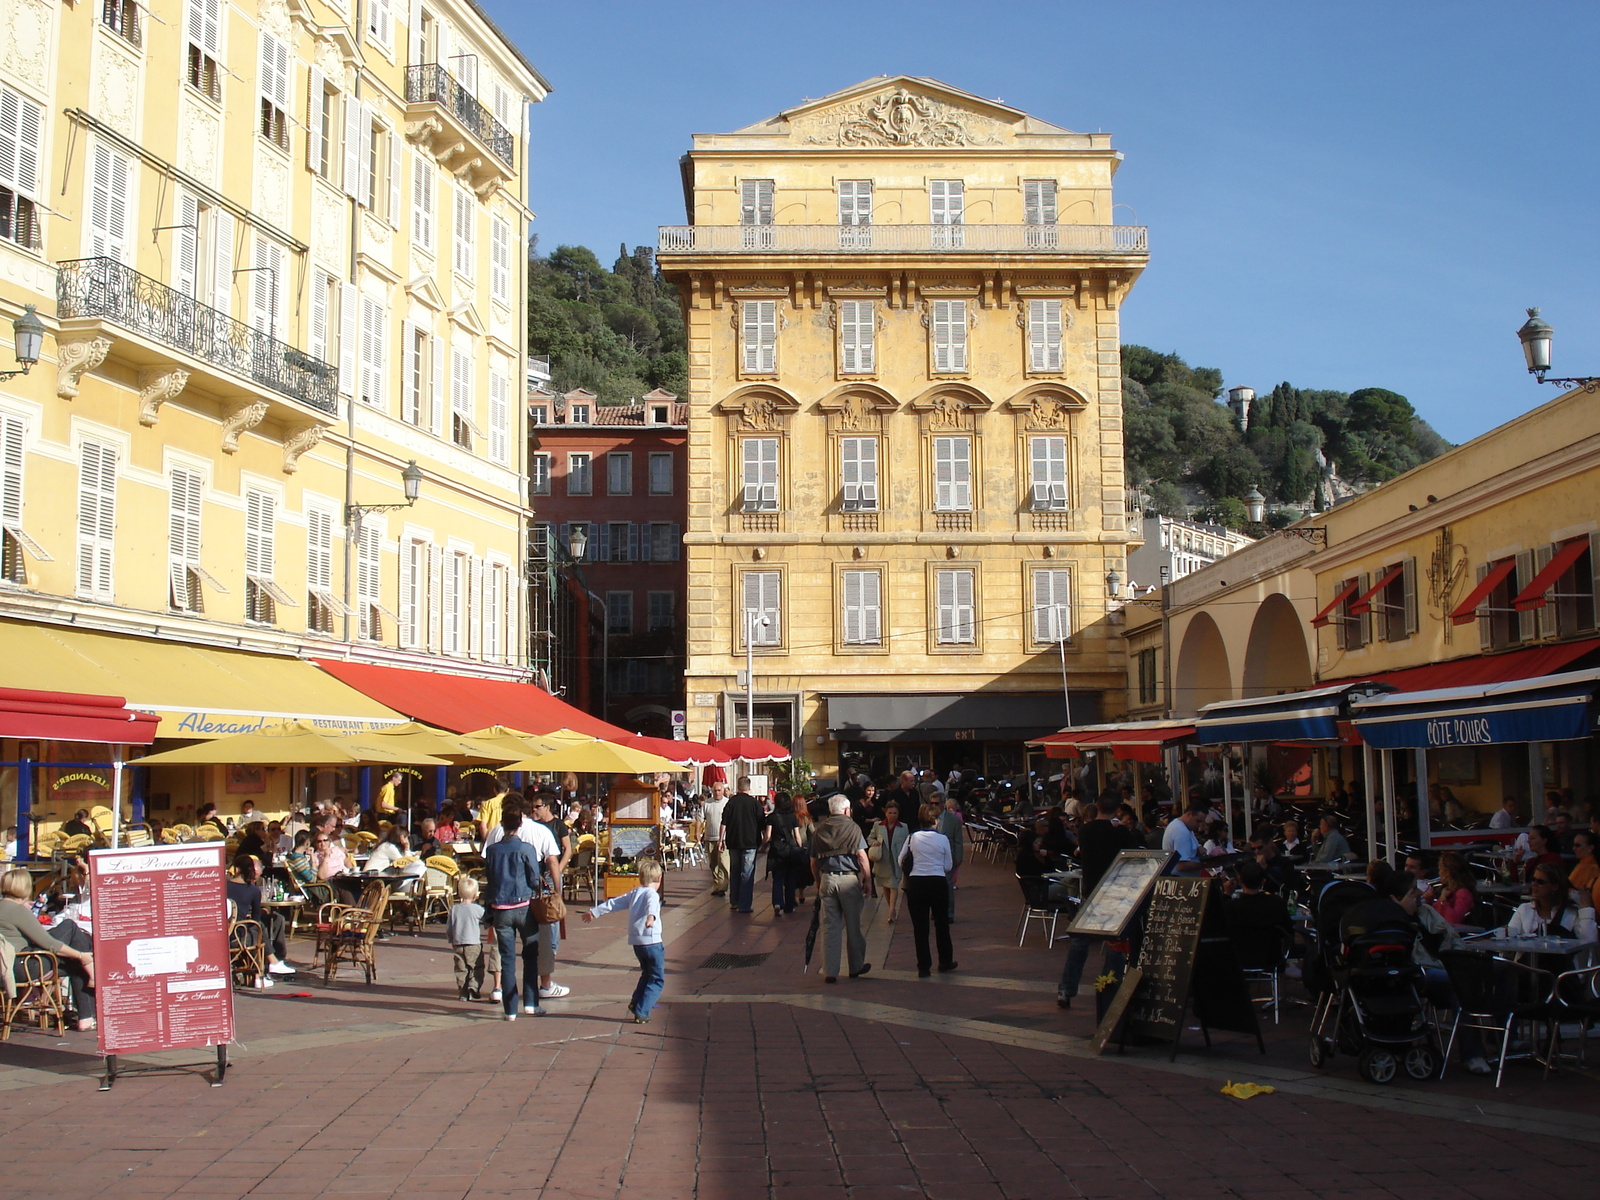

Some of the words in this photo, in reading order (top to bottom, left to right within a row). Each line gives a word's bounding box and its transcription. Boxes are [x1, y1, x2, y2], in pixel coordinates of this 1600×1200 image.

[312, 719, 364, 730] RESTAURANT
[1427, 718, 1454, 746] CÔTE
[108, 858, 132, 871] Les
[140, 856, 210, 870] Ponchettes
[103, 876, 119, 885] Les
[122, 875, 152, 885] Pizzas
[167, 872, 183, 881] Les
[186, 870, 220, 880] Salades
[1154, 879, 1178, 896] MENU
[195, 963, 220, 974] Plats
[107, 971, 124, 980] Les
[175, 994, 189, 1002] Le
[191, 991, 220, 1001] Snack
